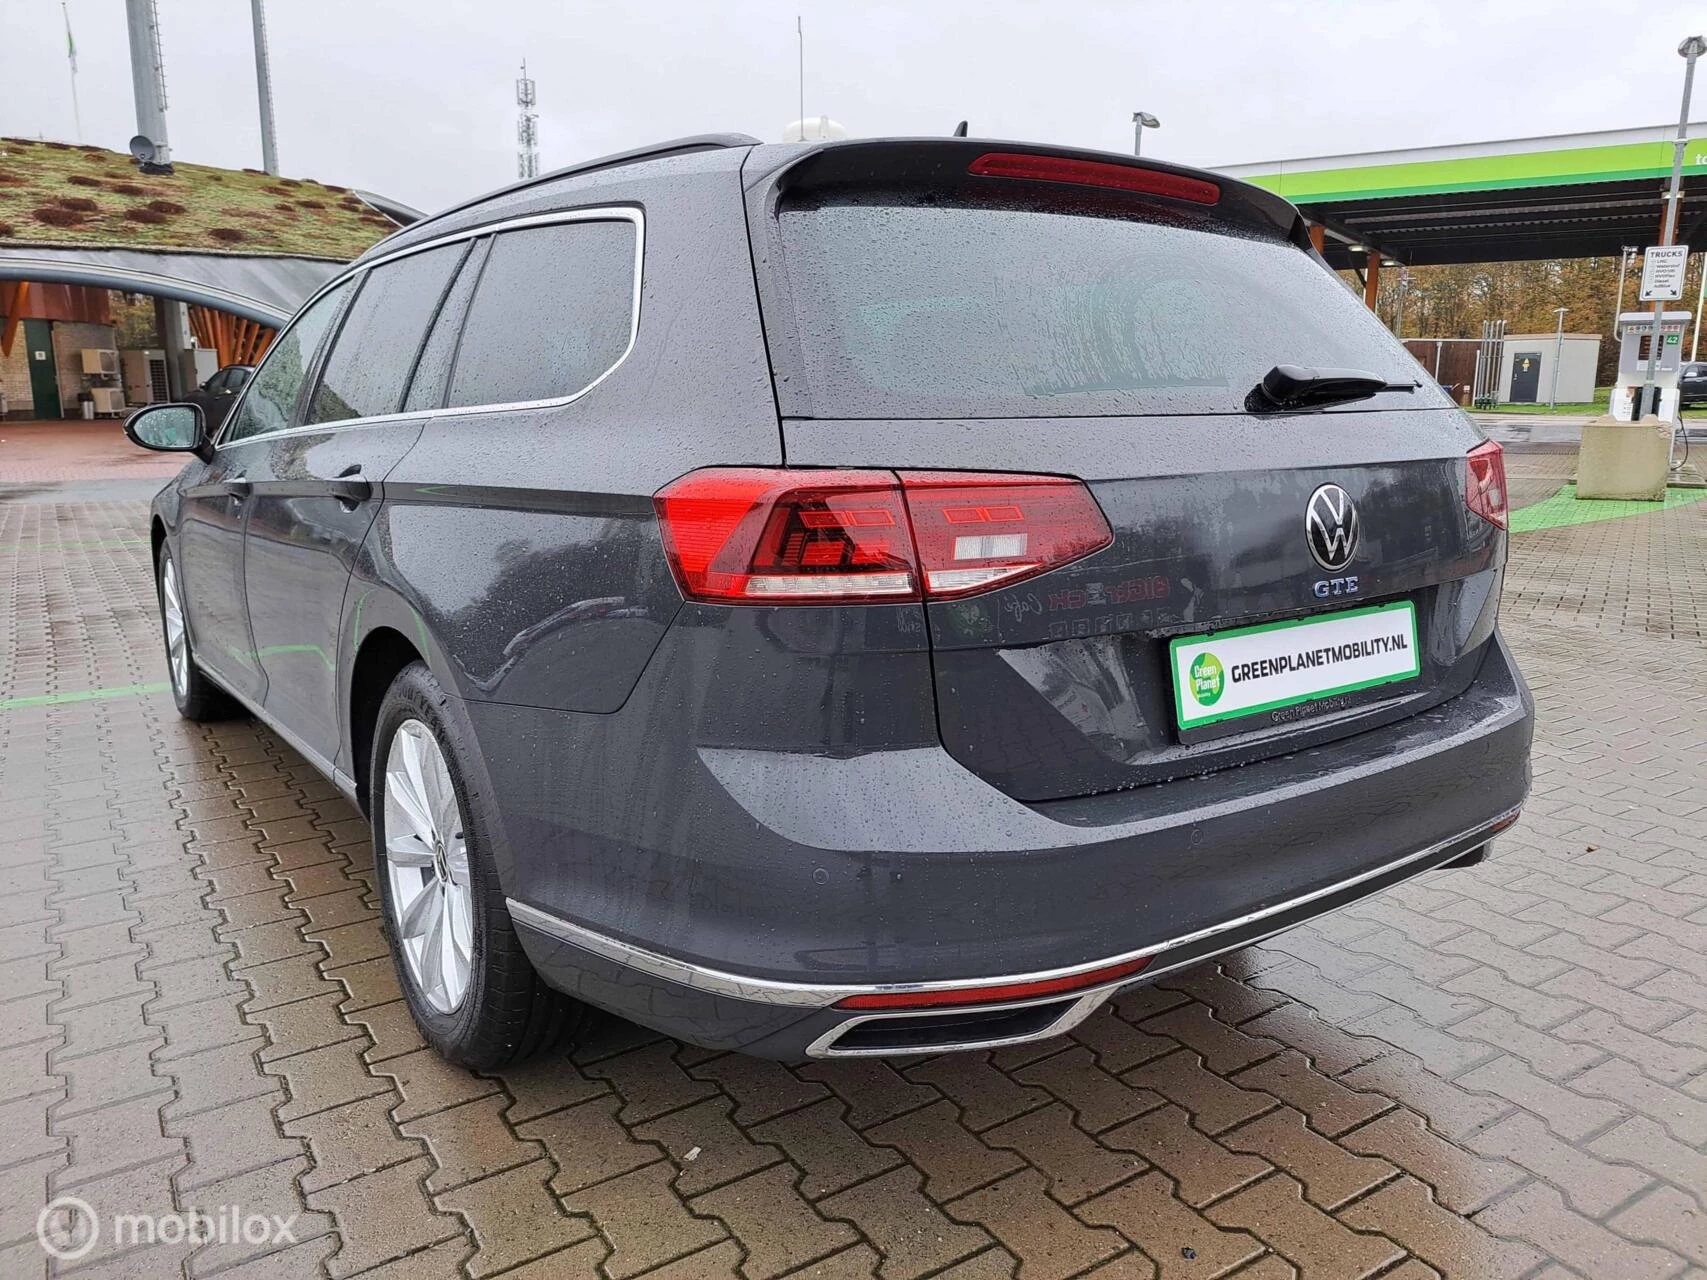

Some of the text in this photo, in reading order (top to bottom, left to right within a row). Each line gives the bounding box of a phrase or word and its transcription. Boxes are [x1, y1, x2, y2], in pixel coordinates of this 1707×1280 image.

[1650, 251, 1683, 259] TRUCKS
[1666, 336, 1679, 345] 42
[1314, 576, 1359, 598] GTE
[1231, 634, 1408, 684] GREENPLANETMOBILITY.NL
[1194, 665, 1217, 678] Green
[1196, 675, 1220, 691] Planet
